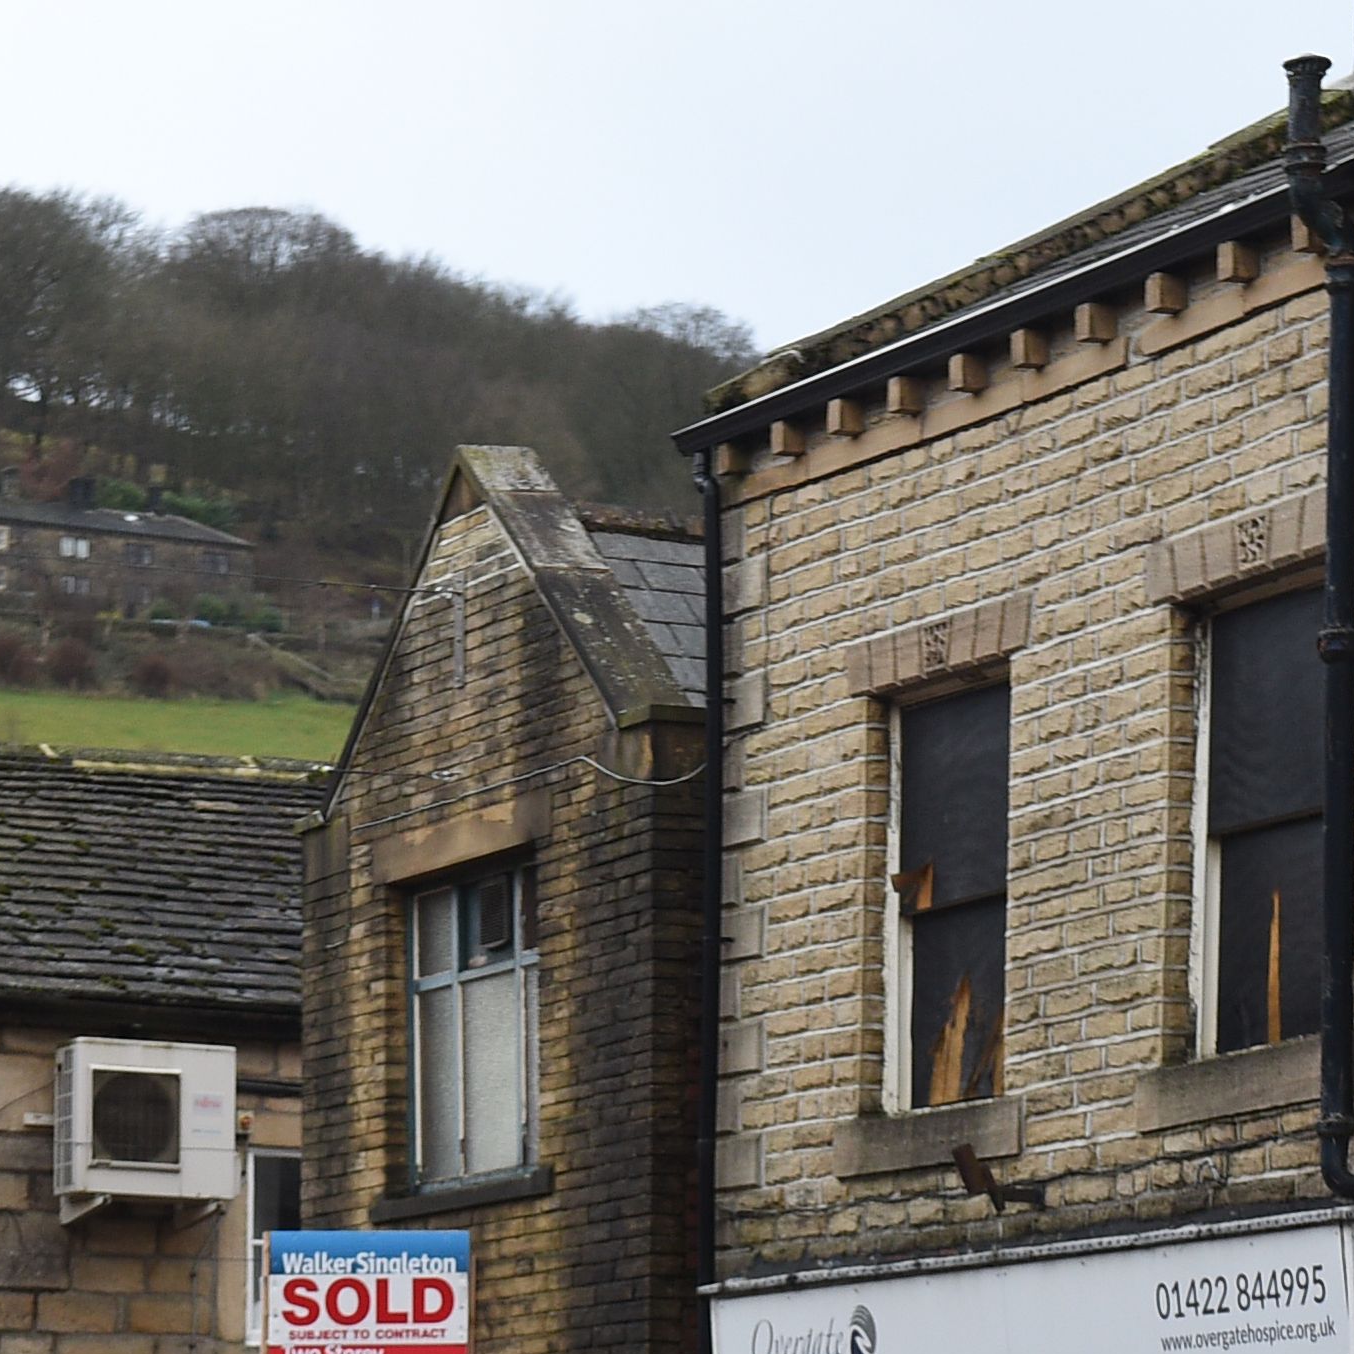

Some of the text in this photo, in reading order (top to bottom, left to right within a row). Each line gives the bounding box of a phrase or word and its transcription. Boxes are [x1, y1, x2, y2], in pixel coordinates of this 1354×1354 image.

[283, 1278, 455, 1326] SOLD
[1156, 1265, 1326, 1319] 01422 844995
[289, 1328, 446, 1340] SUBJECT TO CONTRACT
[1161, 1315, 1336, 1351] www.overgatehospice.org.uk
